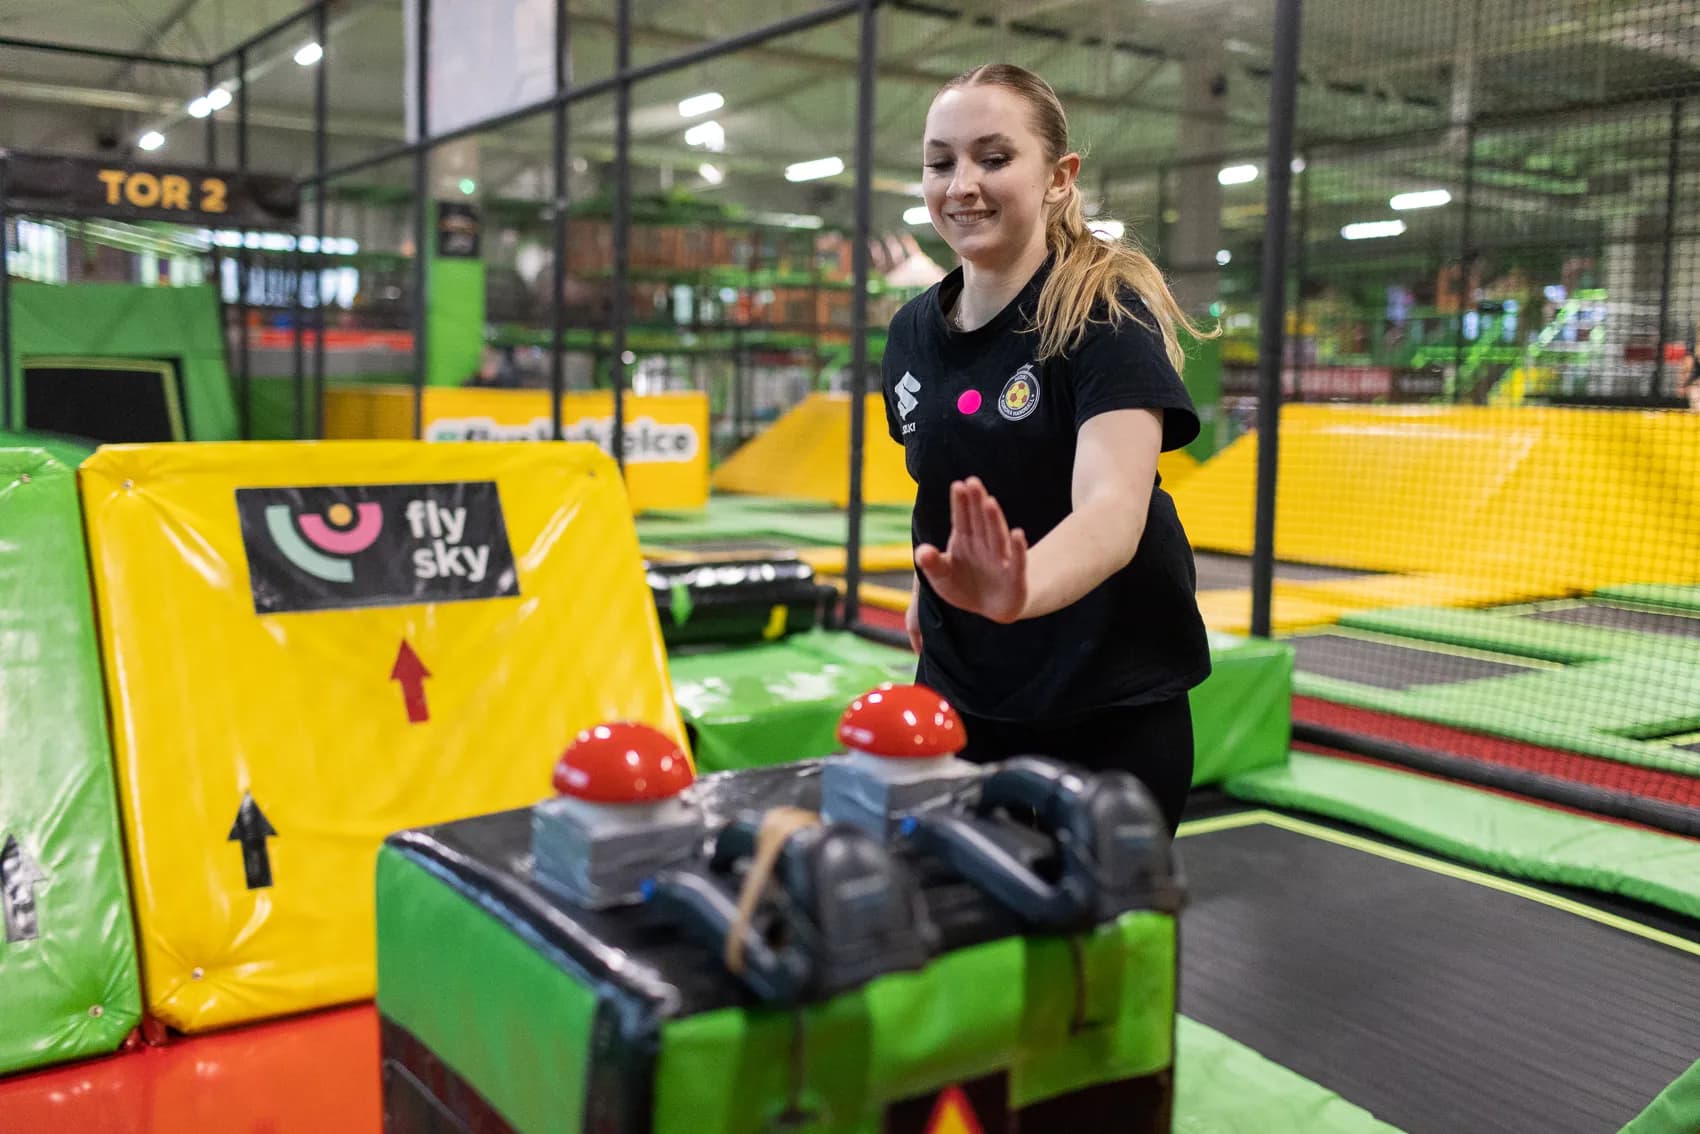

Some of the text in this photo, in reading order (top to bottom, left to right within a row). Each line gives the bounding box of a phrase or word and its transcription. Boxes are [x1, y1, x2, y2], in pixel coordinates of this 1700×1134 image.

[97, 169, 228, 213] TOR 2
[405, 499, 467, 544] fly
[412, 538, 490, 583] sky
